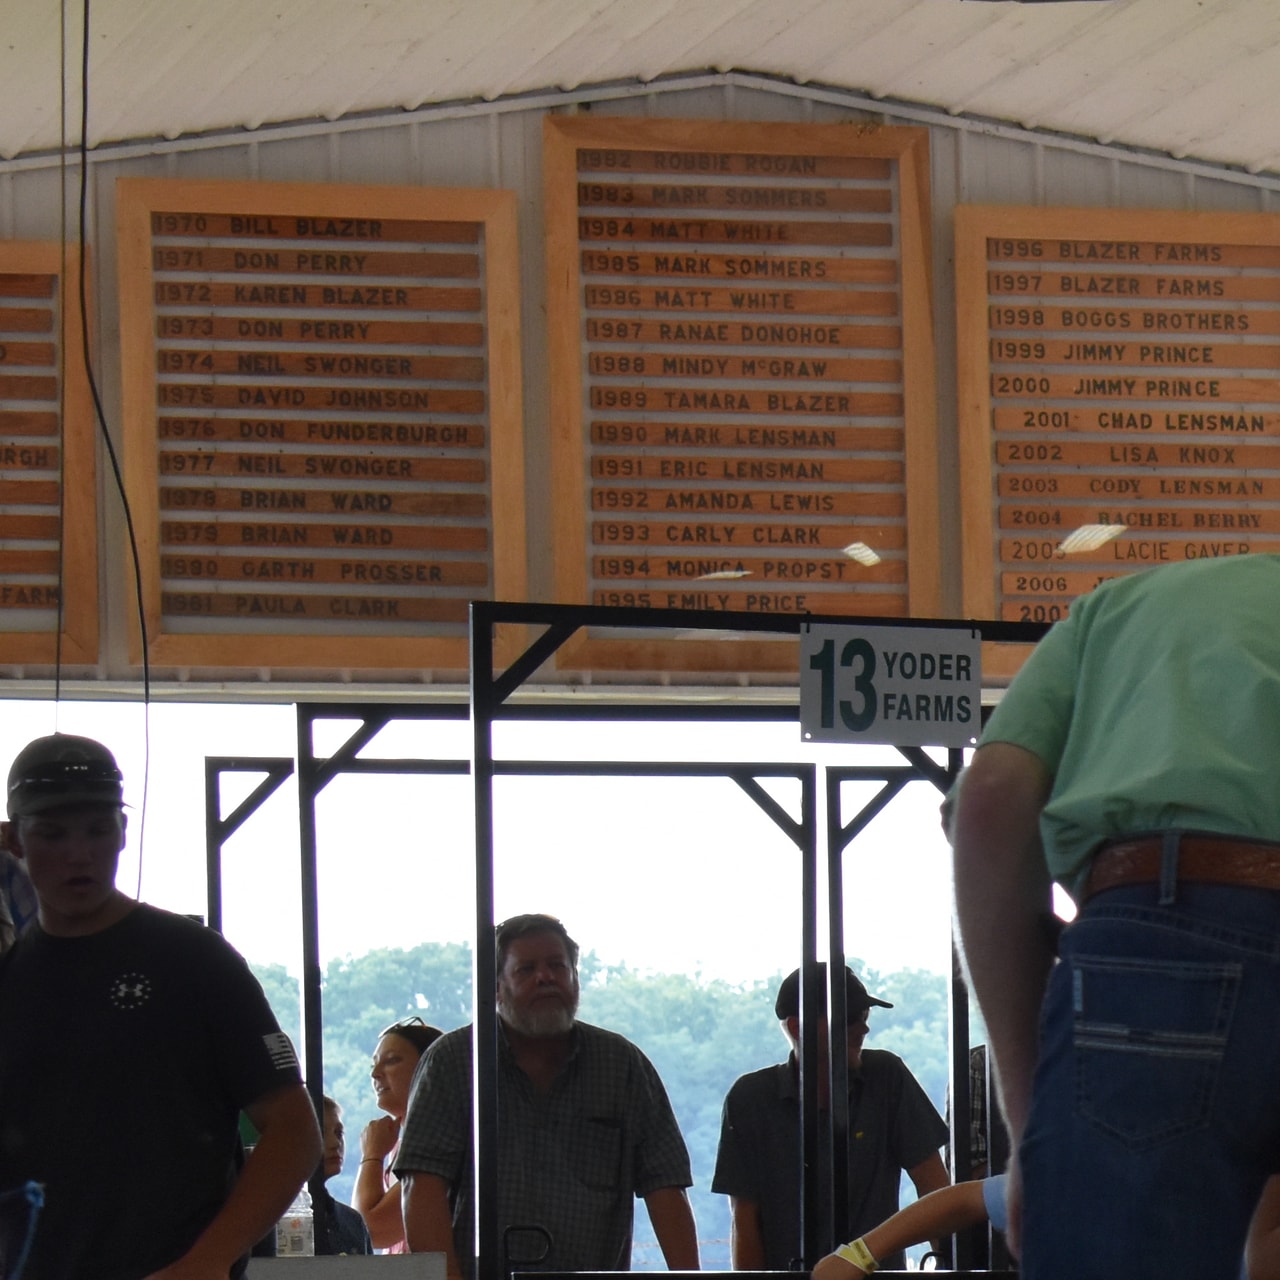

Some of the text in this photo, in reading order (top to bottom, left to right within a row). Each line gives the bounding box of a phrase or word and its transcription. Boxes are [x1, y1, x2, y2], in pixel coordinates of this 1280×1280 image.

[993, 242, 1222, 262] 1996 BLAZER FARMS
[234, 253, 366, 272] DON PERRY
[588, 255, 826, 278] 1985 MARK SOMMERS
[995, 276, 1224, 296] 1997 BLAZER FARMS
[234, 286, 408, 306] KAREN BLAZER
[591, 289, 795, 310] 1986 MATT WHITE
[996, 310, 1249, 330] 1998 BOGGS BROTHERS
[239, 321, 369, 340] DON PERRY
[592, 322, 839, 345] 1987 RANAE DONOHOE
[997, 343, 1214, 363] 1999 JIMMY PRINCE
[238, 357, 413, 375] NEIL SWONGER
[595, 357, 645, 374] 1988
[662, 359, 728, 376] MINDY
[998, 377, 1220, 396] 2000 JIMMY PRINCE
[239, 390, 428, 409] DAVID JOHNSON
[596, 390, 850, 413] 1989 TAMARA BLAZER
[1024, 412, 1264, 432] 2001 CHAD LENSMAN
[240, 423, 468, 443] DON FUNDERBURGH
[597, 426, 837, 447] 1990 MARK LENSMAN
[1009, 445, 1235, 464] 2002 LISA KNOX
[239, 457, 413, 476] NEIL SWONGER
[598, 461, 824, 480] 1991 ERIC LENSMAN
[1009, 478, 1263, 495] 2003 CODY LENSMAN
[597, 492, 834, 511] 1992 AMANDA LEWIS
[1012, 511, 1262, 528] 2004 RACHEL BERRY
[242, 528, 393, 546] BRIAN WARD
[598, 525, 821, 544] 1993 CARLY CLARK
[1115, 543, 1169, 560] LACIE
[243, 563, 443, 582] GARTH PROSSER
[599, 559, 847, 579] 1994 PROPST
[1017, 577, 1067, 592] 2006
[599, 593, 808, 612] 1995 EMILY PRICE
[883, 652, 971, 681] YODER
[810, 639, 877, 732] 13
[883, 694, 971, 722] FARMS
